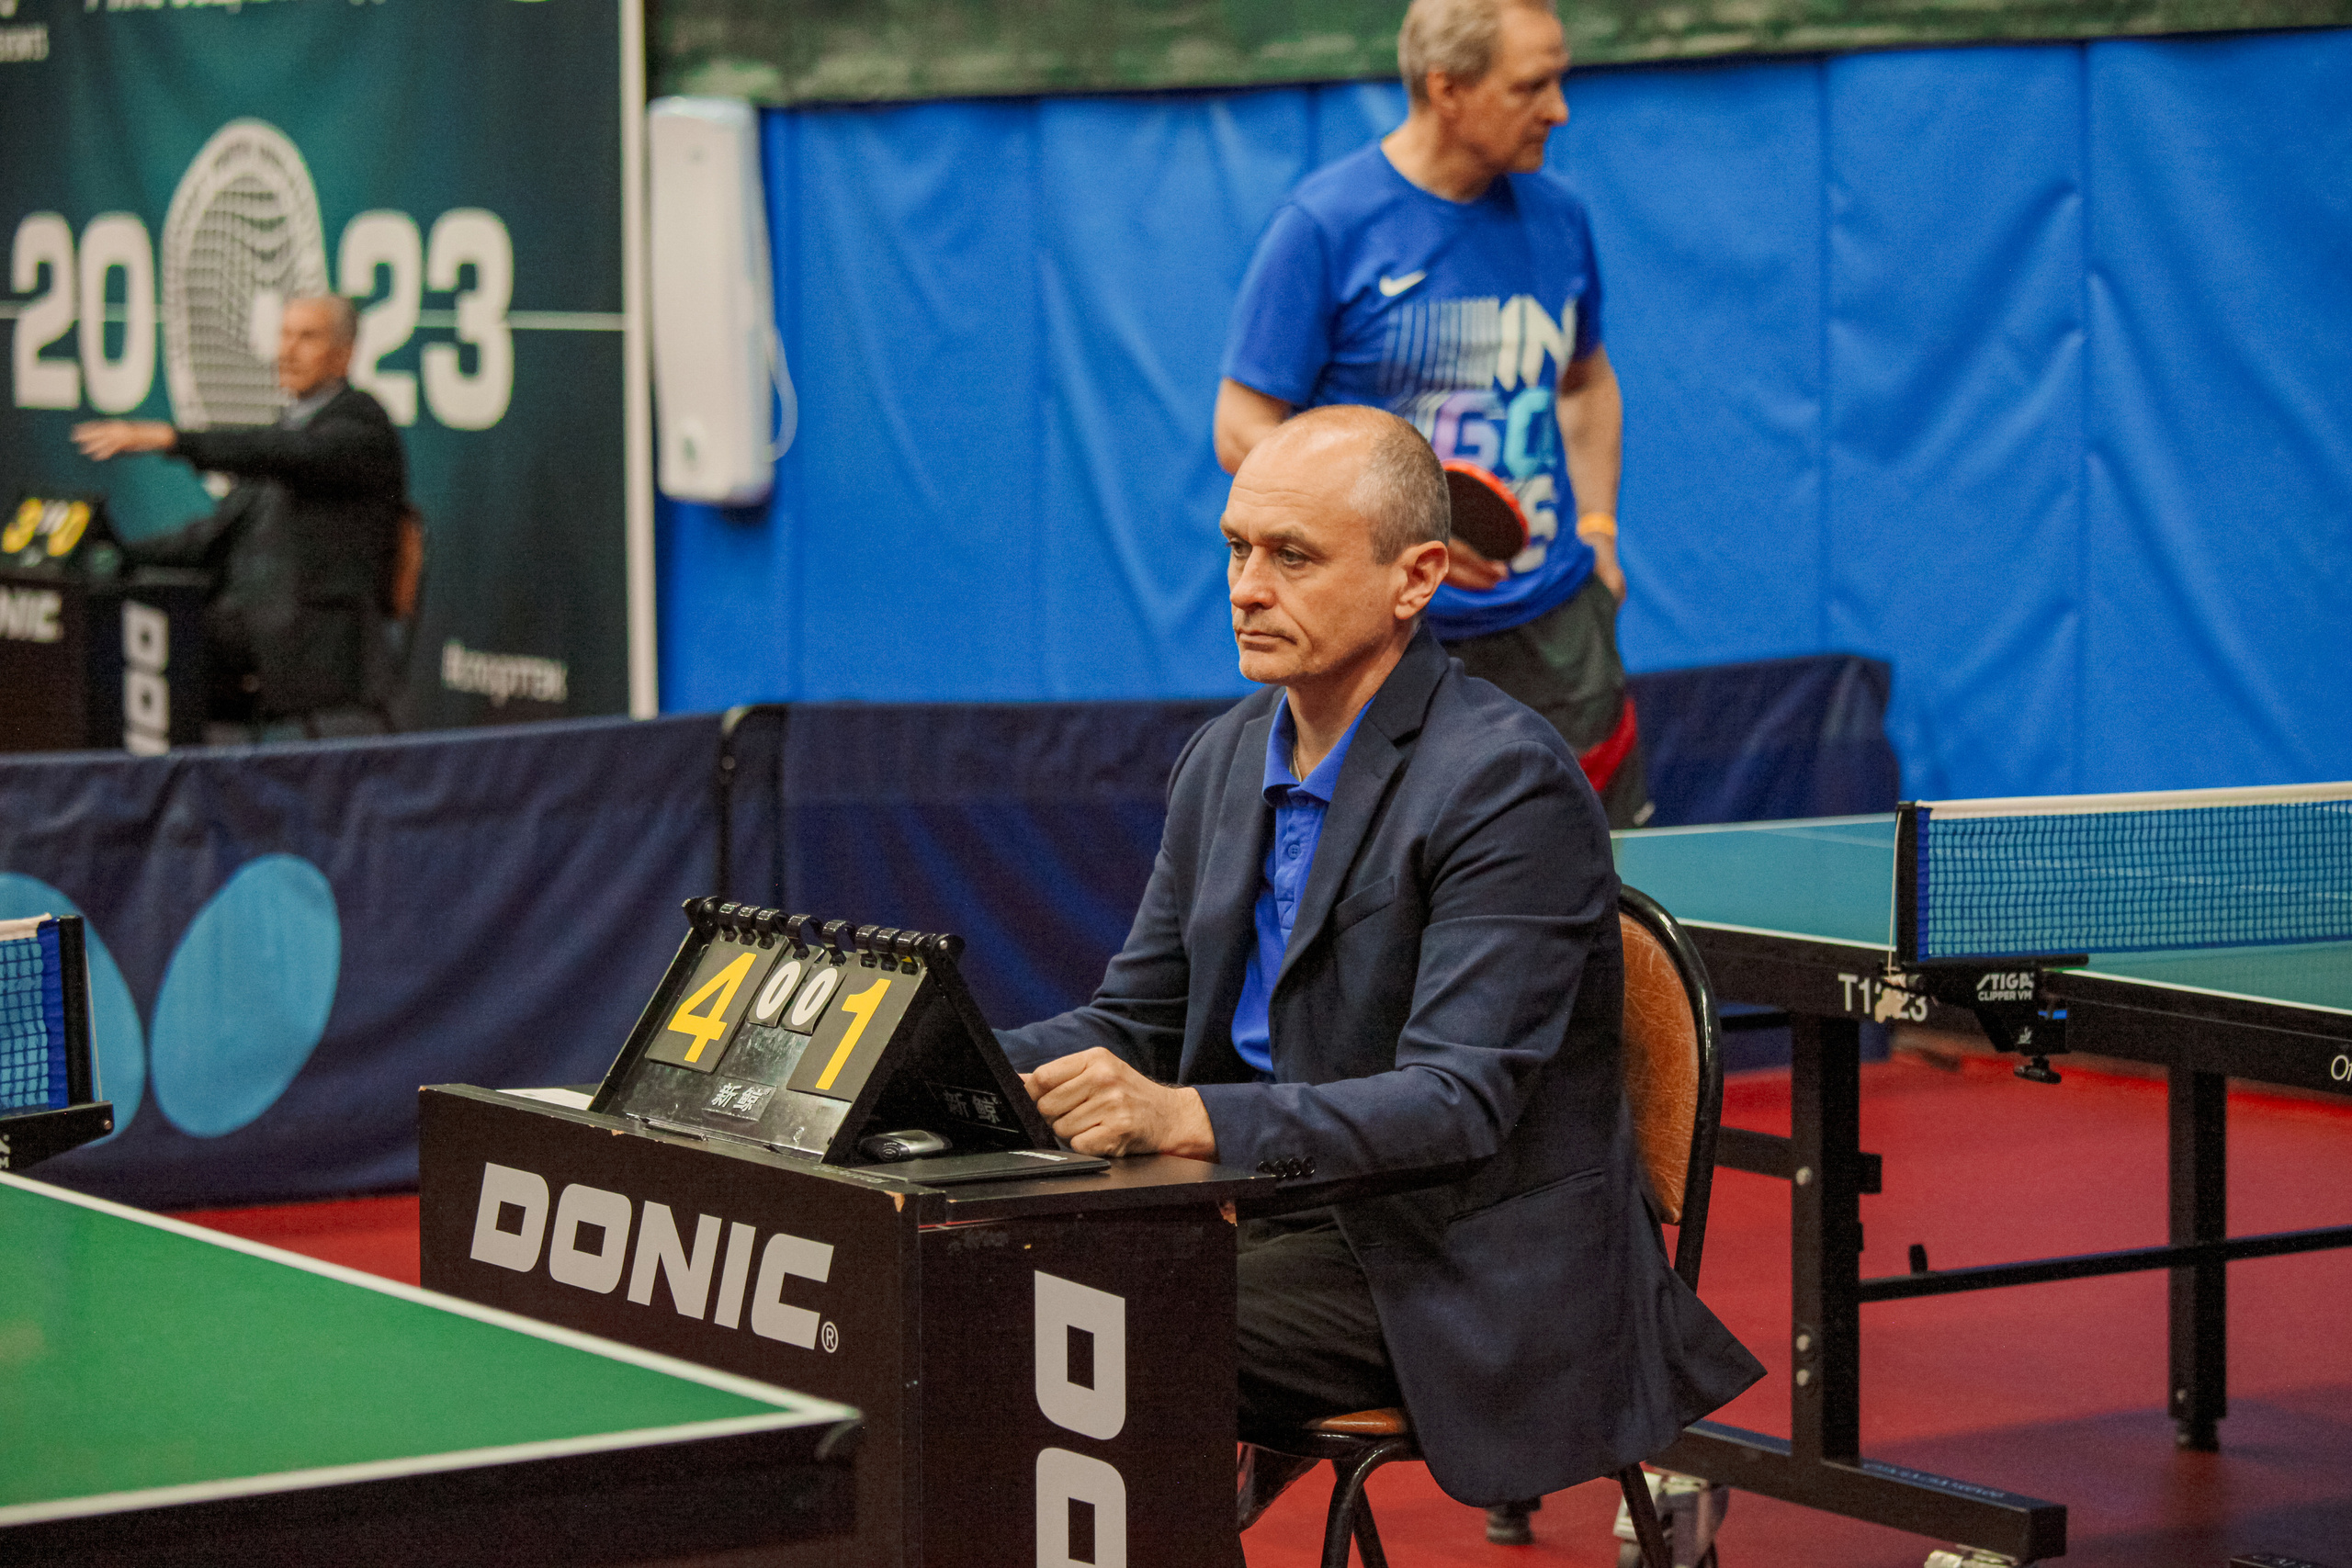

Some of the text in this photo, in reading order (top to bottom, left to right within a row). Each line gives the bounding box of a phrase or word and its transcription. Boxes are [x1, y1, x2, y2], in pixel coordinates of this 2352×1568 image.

[11, 208, 514, 430] 20 23
[668, 952, 757, 1063] 4
[815, 978, 892, 1090] 1
[1978, 990, 2033, 1002] CLIPPER VM
